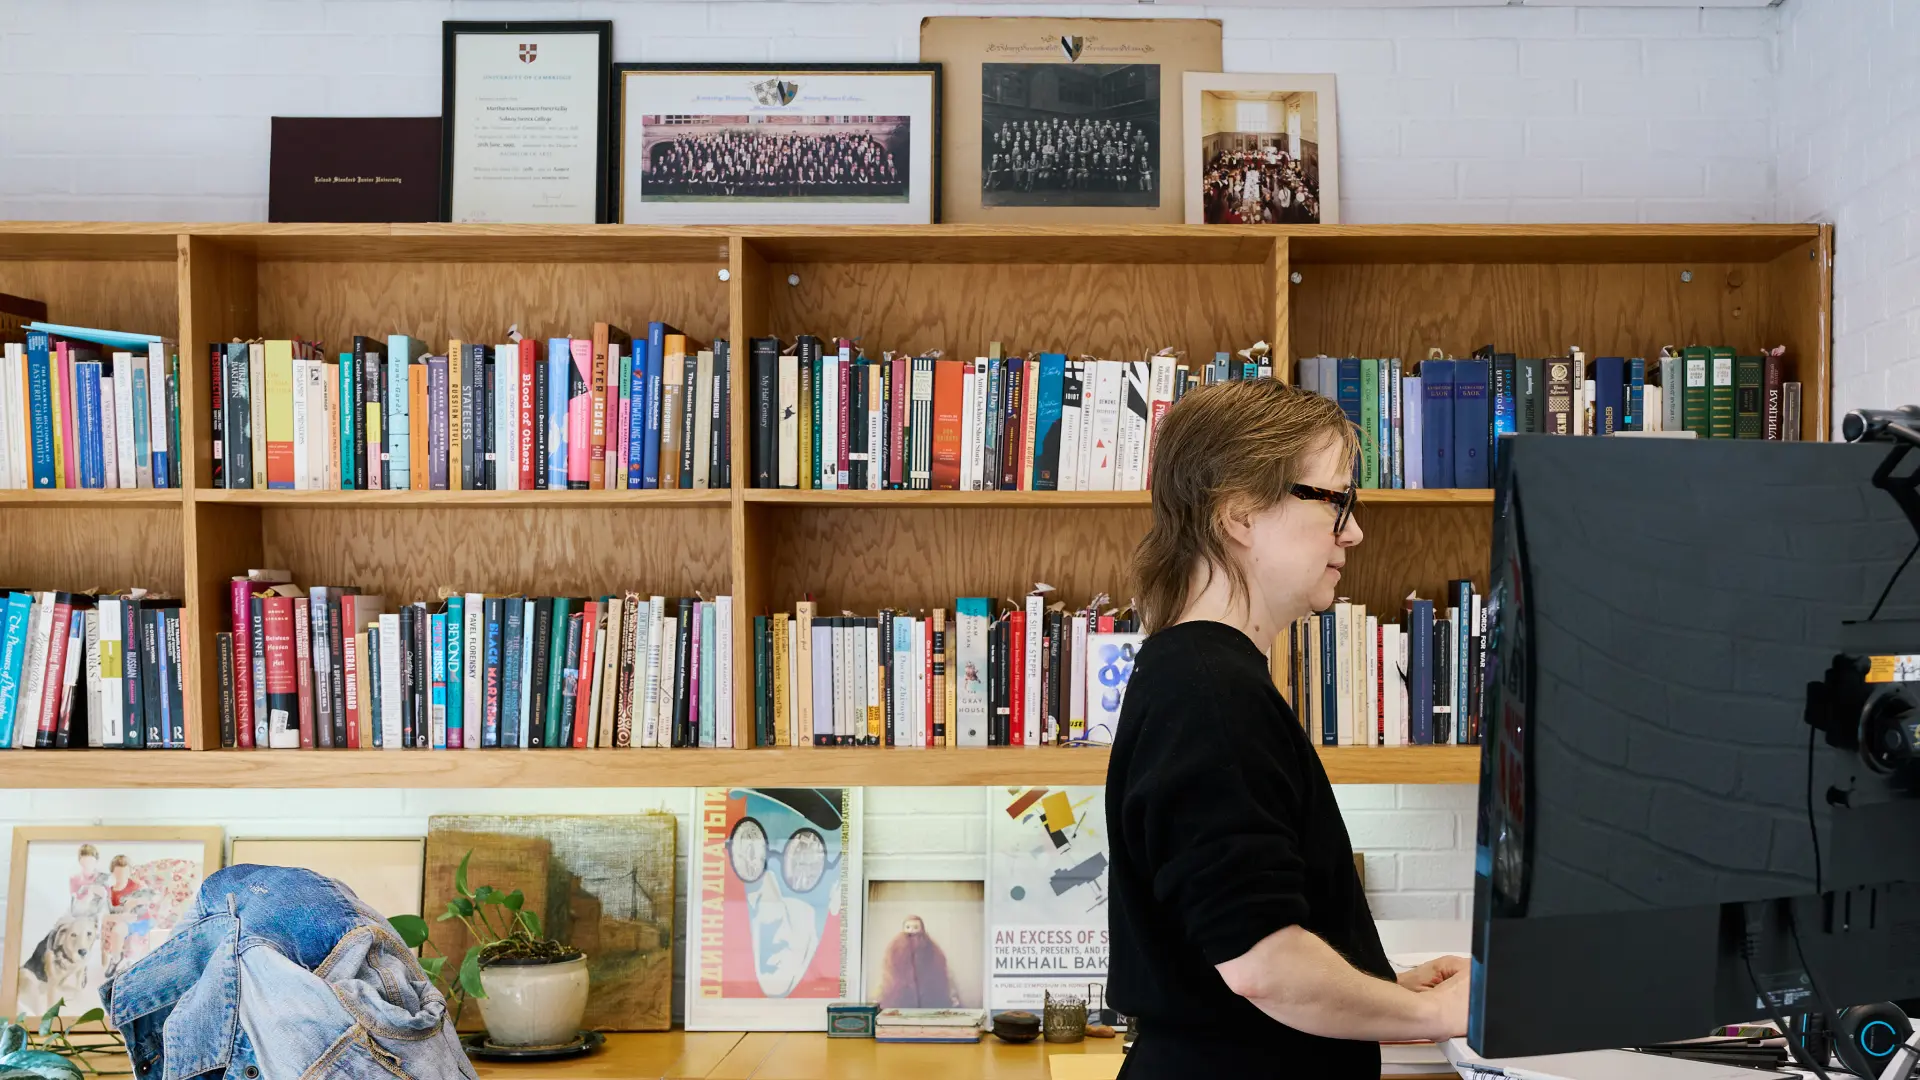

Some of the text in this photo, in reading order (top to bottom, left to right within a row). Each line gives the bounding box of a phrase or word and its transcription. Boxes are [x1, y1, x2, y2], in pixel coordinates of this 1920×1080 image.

[212, 352, 220, 408] RESURRECTION
[474, 348, 482, 388] CINEMASAURUS
[761, 375, 768, 386] My
[991, 361, 999, 380] Night
[463, 386, 471, 440] STATELESS
[594, 354, 604, 436] ALTER ICONS
[989, 395, 997, 408] Day
[1495, 370, 1504, 415] бродский
[32, 364, 43, 464] EASTERN CHRISTIANITY
[439, 411, 444, 419] OF
[522, 373, 531, 471] Blood of Others
[631, 380, 642, 461] AN INDWELLING VOICE
[760, 403, 768, 427] Century
[1768, 390, 1778, 440] УЛИЦКАЯ
[9, 612, 22, 633] The
[538, 612, 547, 658] RECORDING
[1029, 621, 1037, 648] SILENT
[4, 635, 18, 669] Pleasures
[87, 612, 97, 678] LANDMARKS
[127, 652, 136, 678] RUSSIAN
[254, 616, 264, 700] DIVINE SOPHIA
[448, 624, 459, 673] BEYOND
[1028, 651, 1036, 679] STEPPE
[42, 622, 64, 726] Reimagining Denominationalism
[235, 623, 248, 729] PICTURING RUSSIA
[345, 639, 356, 711] ILLIBERAL VANGUARD
[435, 652, 444, 682] RUSSIA
[488, 625, 498, 727] BLACK MARXISM
[897, 686, 907, 722] Zhivago
[996, 931, 1095, 944] AN EXCESS OF
[1012, 947, 1037, 956] PASTS,
[1041, 947, 1082, 956] PRESENTS,
[996, 957, 1068, 969] MIKHAIL
